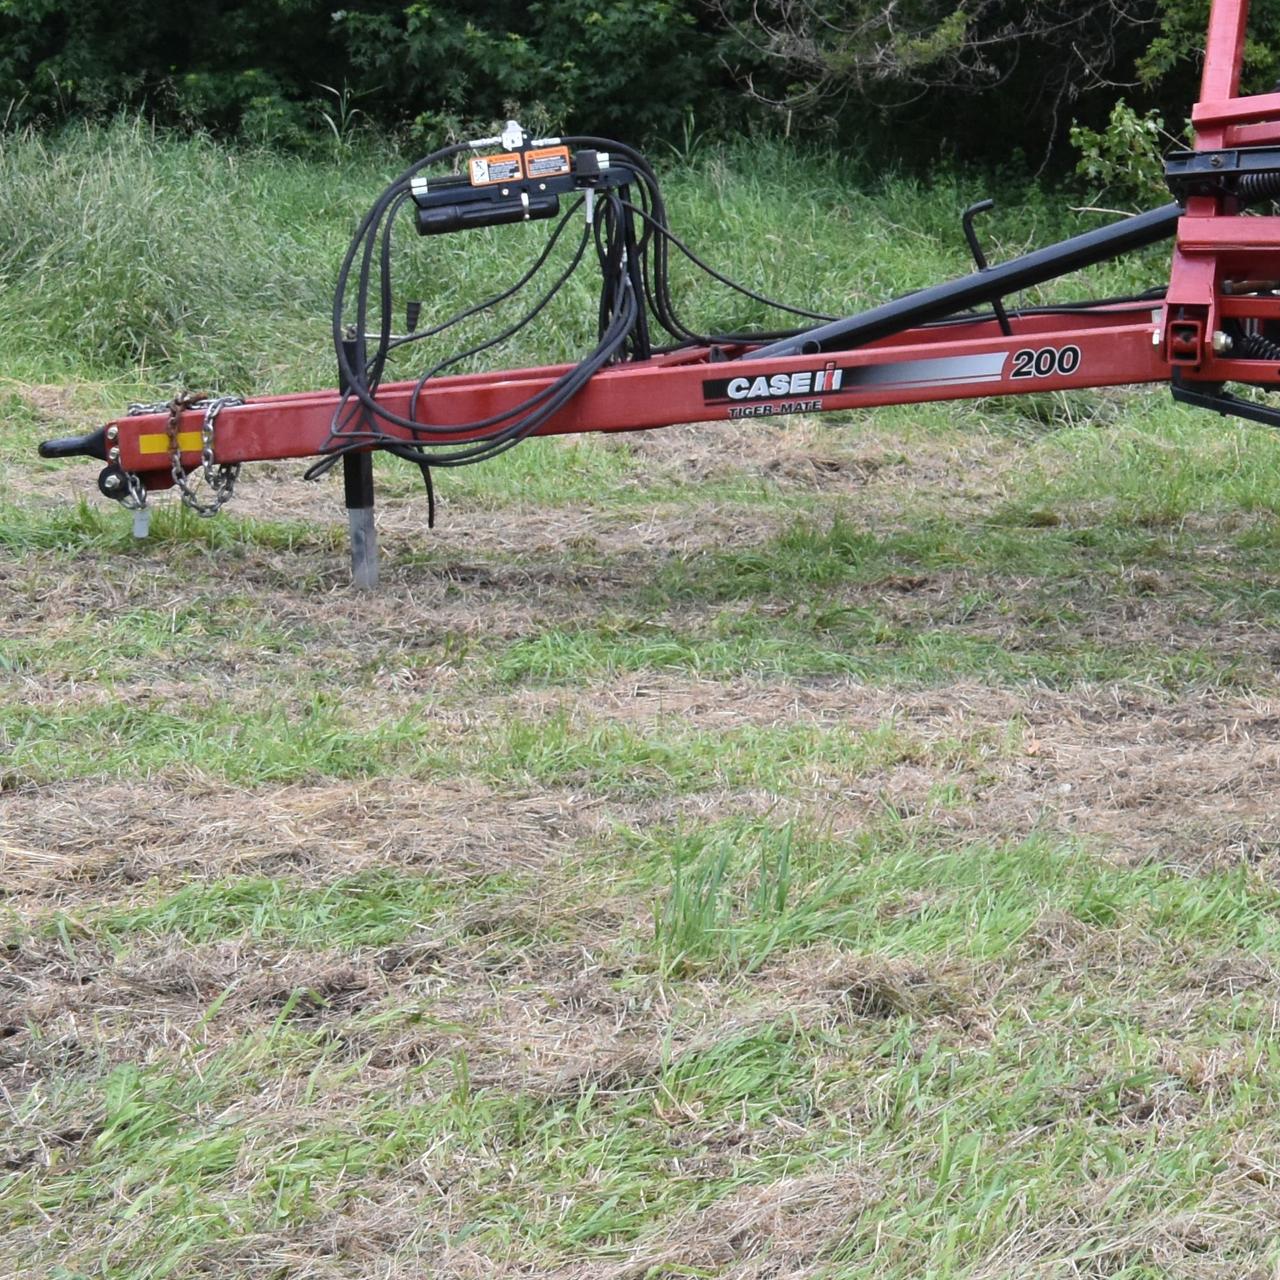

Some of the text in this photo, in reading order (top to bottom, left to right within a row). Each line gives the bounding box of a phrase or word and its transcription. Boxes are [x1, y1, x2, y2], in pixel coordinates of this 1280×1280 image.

[1011, 345, 1081, 379] 200
[727, 372, 811, 400] CASE
[728, 400, 822, 418] TIGER-MATE
